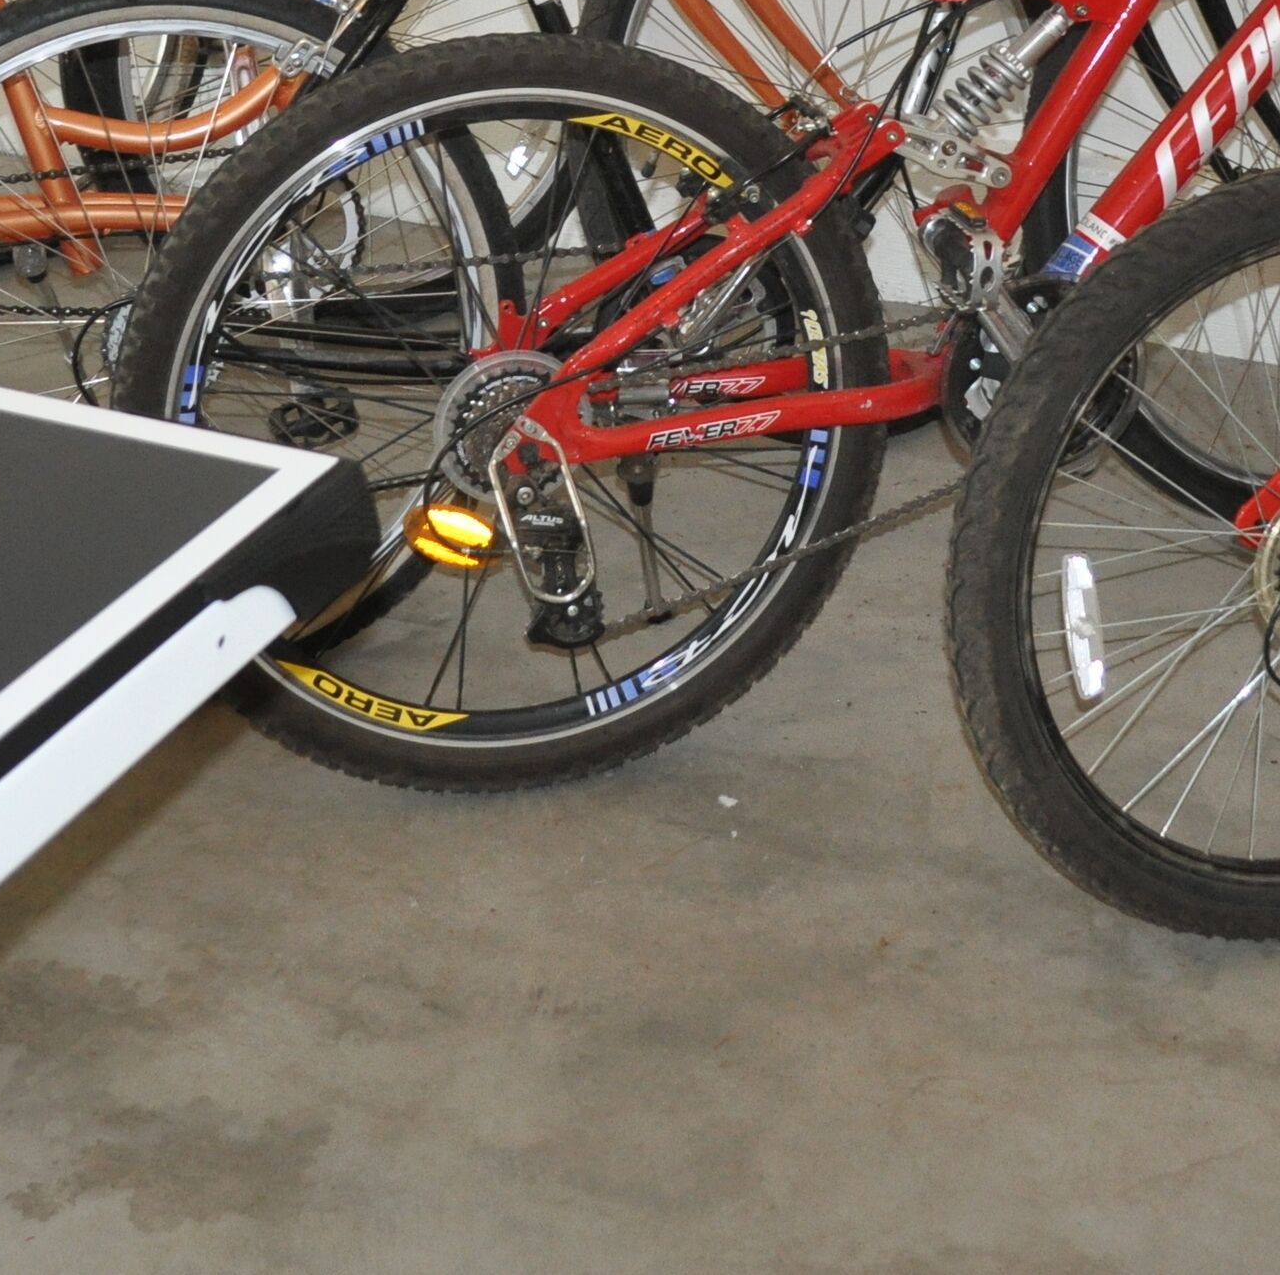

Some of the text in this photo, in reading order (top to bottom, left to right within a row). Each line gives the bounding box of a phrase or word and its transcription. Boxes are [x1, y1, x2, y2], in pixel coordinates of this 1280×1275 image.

[598, 116, 722, 181] AERO
[520, 514, 564, 524] ALTUS
[312, 674, 438, 727] AERO
